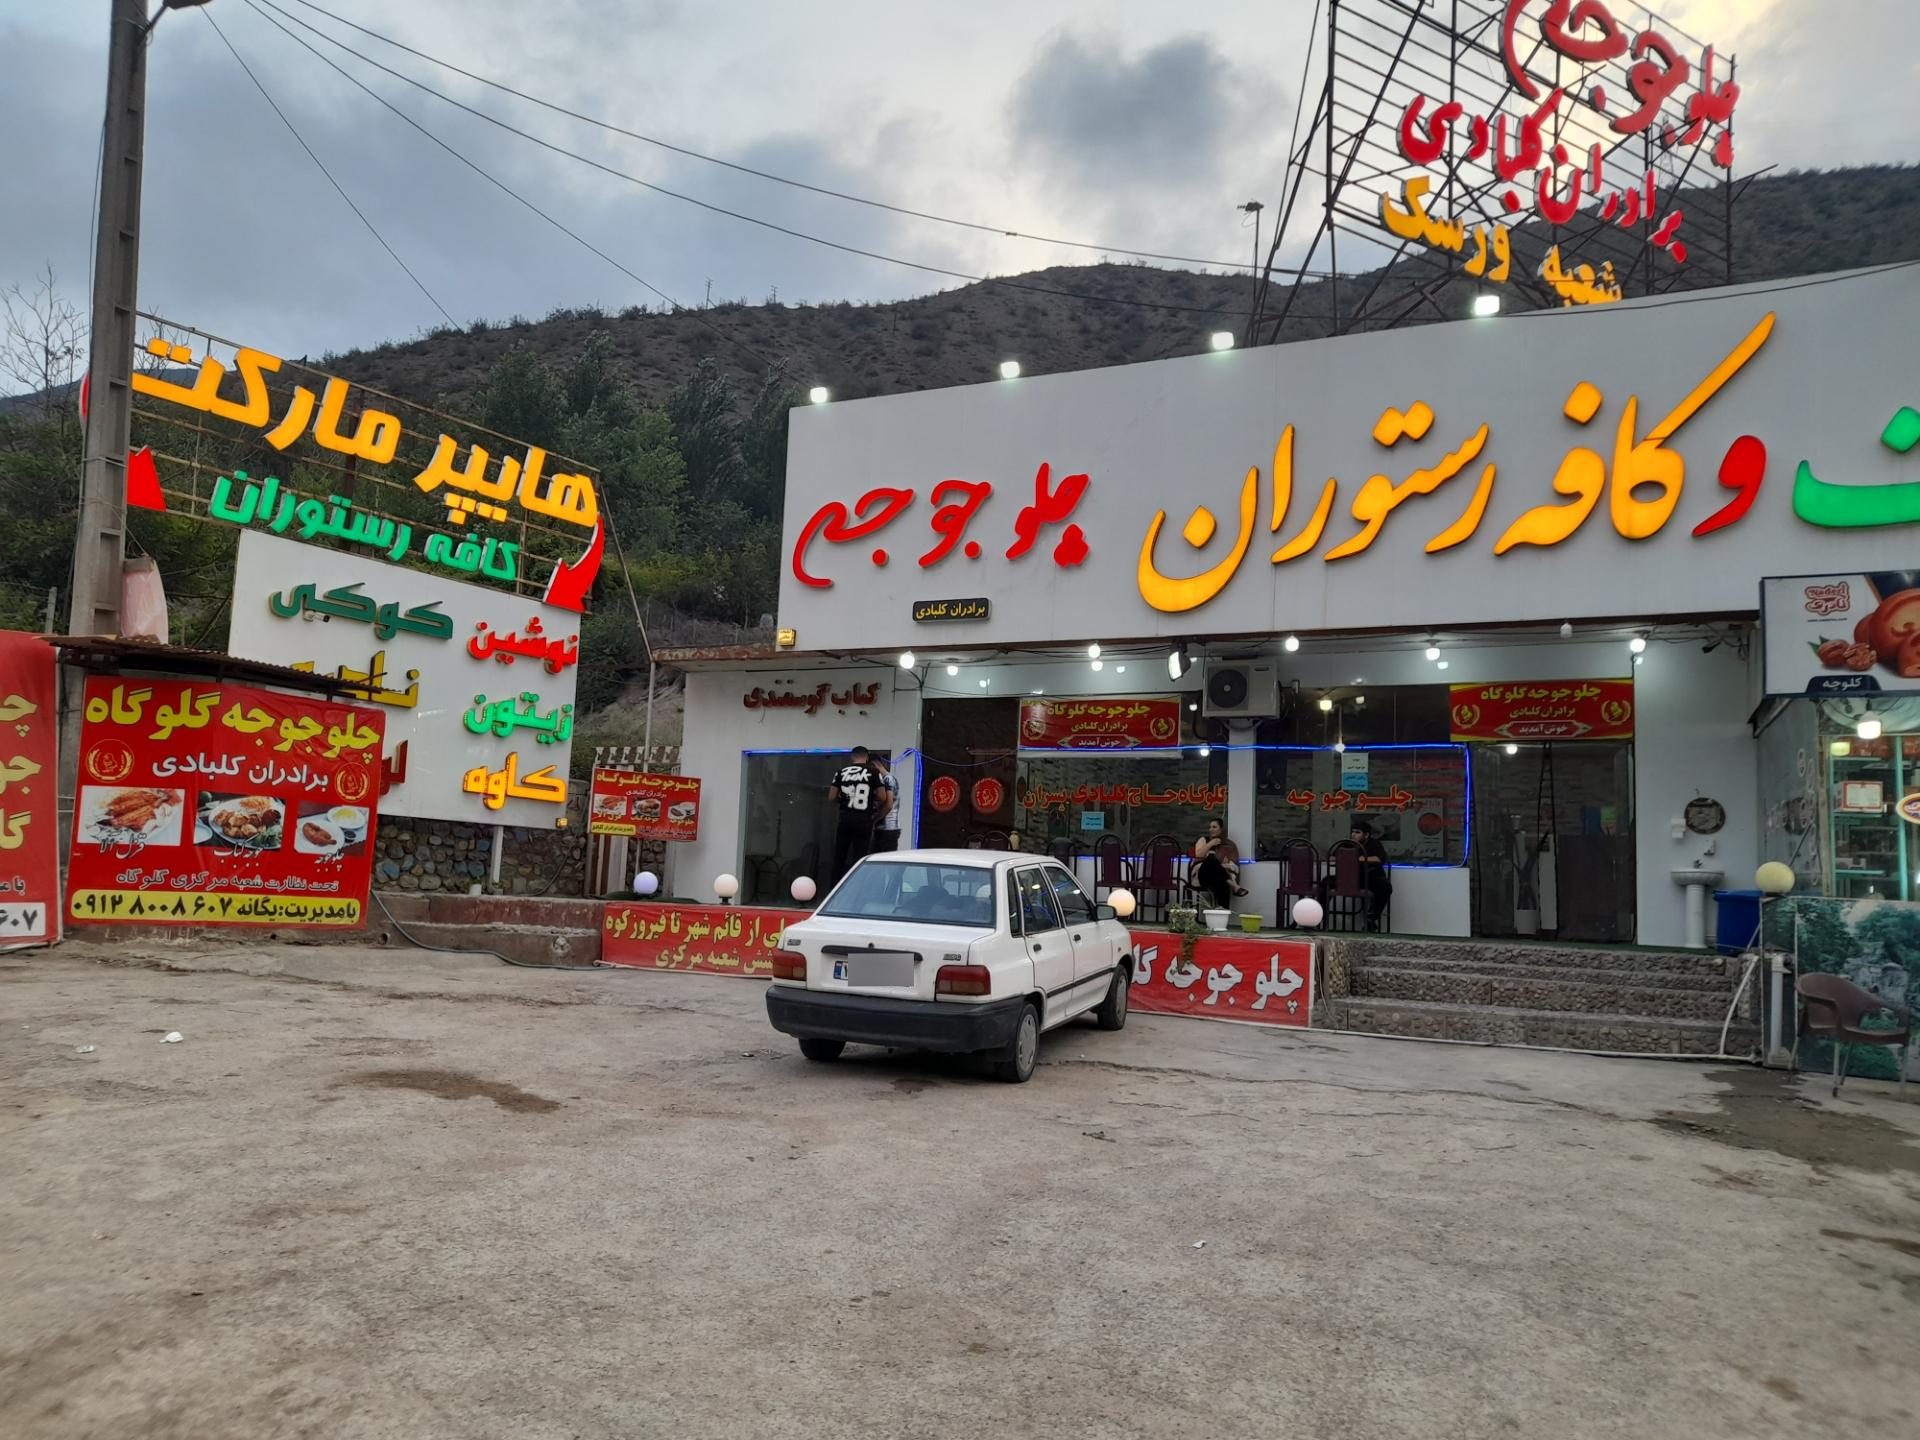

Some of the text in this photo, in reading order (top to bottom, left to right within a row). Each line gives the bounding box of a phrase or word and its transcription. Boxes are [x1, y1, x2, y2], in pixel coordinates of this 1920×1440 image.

[1397, 87, 1688, 264] برادران کلبادی
[1380, 175, 1510, 281] ورسک
[131, 337, 599, 528] هایپر مارکت
[1494, 311, 1776, 557] کافه
[1005, 462, 1090, 569] چلو
[1139, 400, 1497, 613] رستوران
[209, 470, 521, 581] کافه رستوران
[269, 582, 453, 640] کوکی
[915, 600, 986, 620] برادران کلبادی
[467, 616, 578, 674] نوشین
[831, 682, 881, 715] کباب
[1528, 687, 1572, 703] جوجه
[1574, 684, 1602, 702] چلو
[463, 691, 573, 745] زیتون
[1088, 703, 1126, 718] جوجه
[1127, 702, 1151, 719] چلو
[1509, 705, 1576, 719] برادران کلبادی
[1071, 721, 1129, 734] برادران کلبادی
[1078, 736, 1120, 748] خوش آمدید
[1519, 723, 1568, 735] خوش آمدید
[152, 752, 329, 793] برادران کلبادی
[230, 872, 263, 893] شعبه
[265, 876, 307, 893] نظارت
[308, 878, 339, 892] تحت
[670, 911, 682, 934] تا
[684, 913, 710, 943] شهر
[713, 912, 742, 944] قائم
[745, 916, 760, 947] از
[707, 947, 740, 970] شعبه
[1165, 955, 1244, 1006] جوجه
[1251, 952, 1304, 1015] چلو
